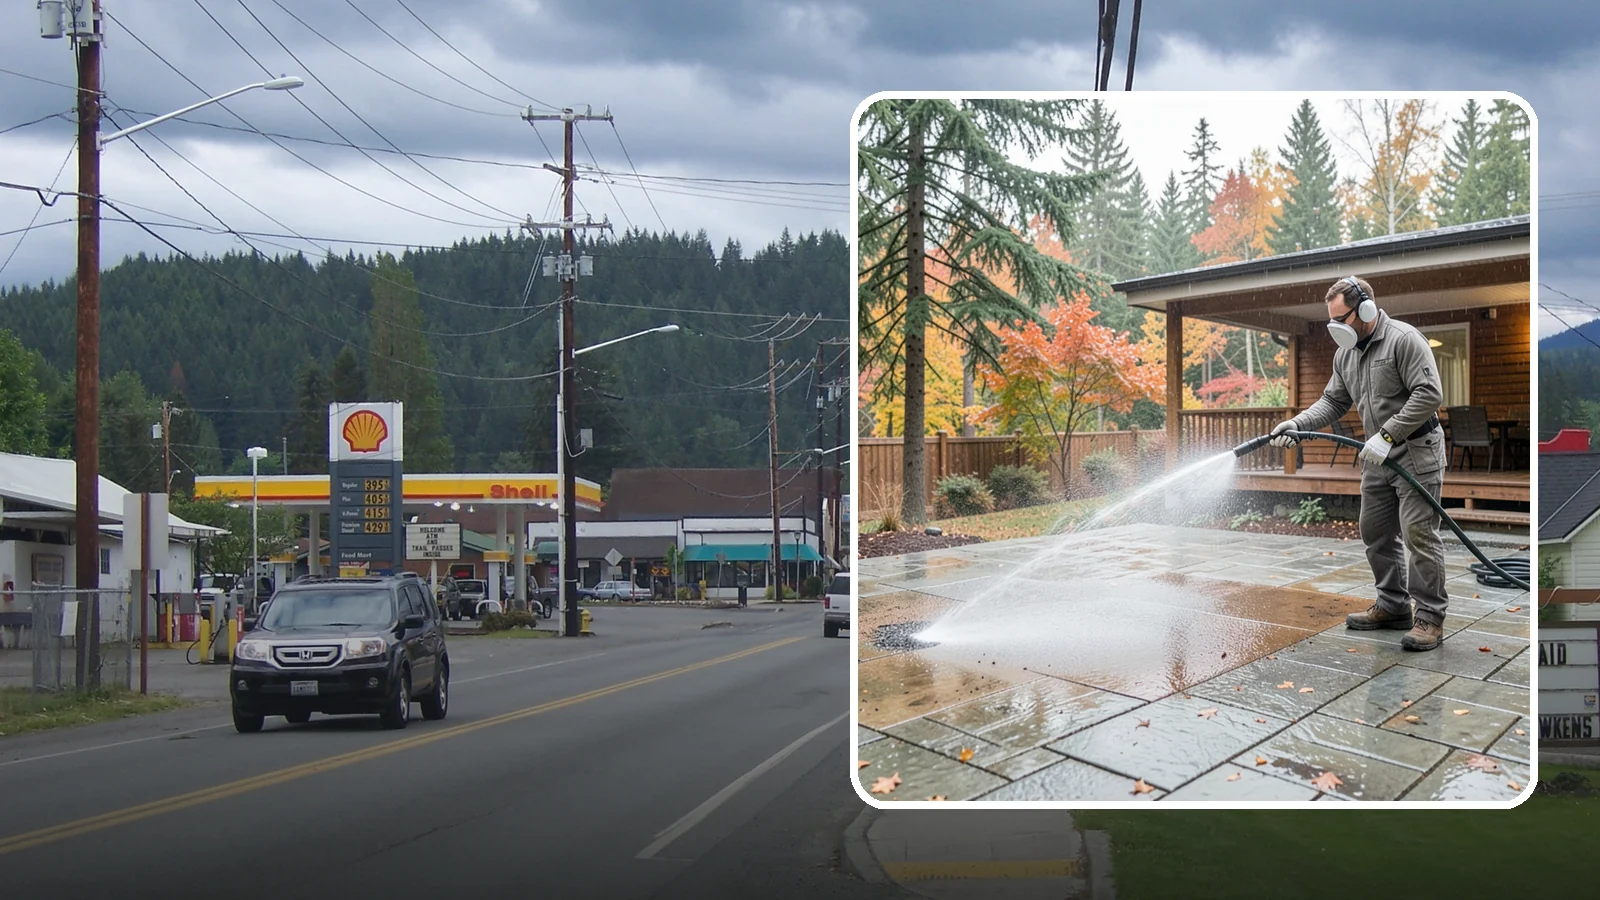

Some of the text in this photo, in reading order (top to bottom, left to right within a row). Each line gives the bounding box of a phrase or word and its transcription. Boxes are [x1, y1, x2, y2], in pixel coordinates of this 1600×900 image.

[366, 480, 383, 490] 395
[490, 484, 547, 499] Shell
[366, 494, 383, 504] 405
[366, 508, 383, 518] 415
[366, 522, 383, 533] 429
